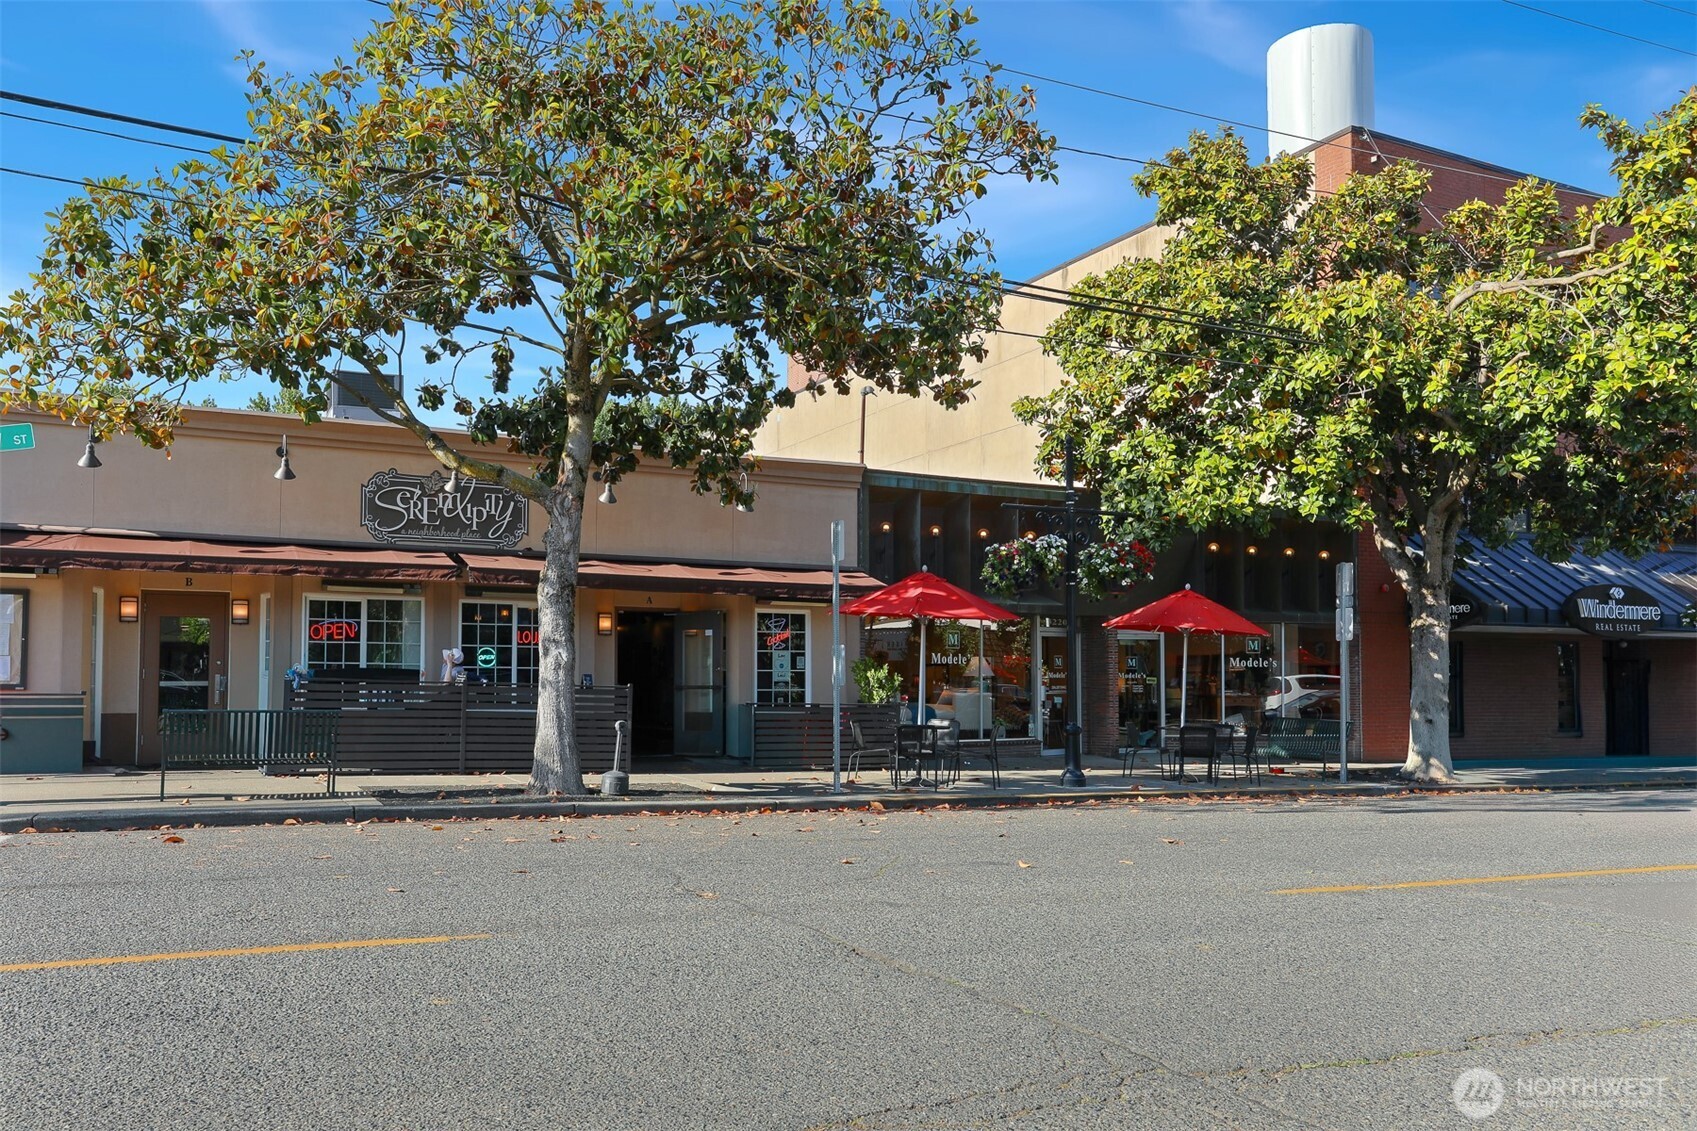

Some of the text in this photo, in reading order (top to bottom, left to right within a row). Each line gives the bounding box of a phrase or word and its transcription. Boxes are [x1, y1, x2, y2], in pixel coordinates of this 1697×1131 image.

[13, 434, 27, 445] ST
[407, 525, 460, 539] neighborhood
[460, 528, 482, 543] place
[185, 577, 193, 586] B
[646, 596, 653, 604] A
[1577, 598, 1661, 621] Windermere
[310, 623, 355, 640] OPEN
[1595, 623, 1641, 632] REAL ESTATE
[517, 630, 540, 644] LOU
[948, 633, 958, 645] M
[1248, 640, 1258, 651] M
[1127, 658, 1136, 667] M
[1229, 657, 1278, 668] Modele's
